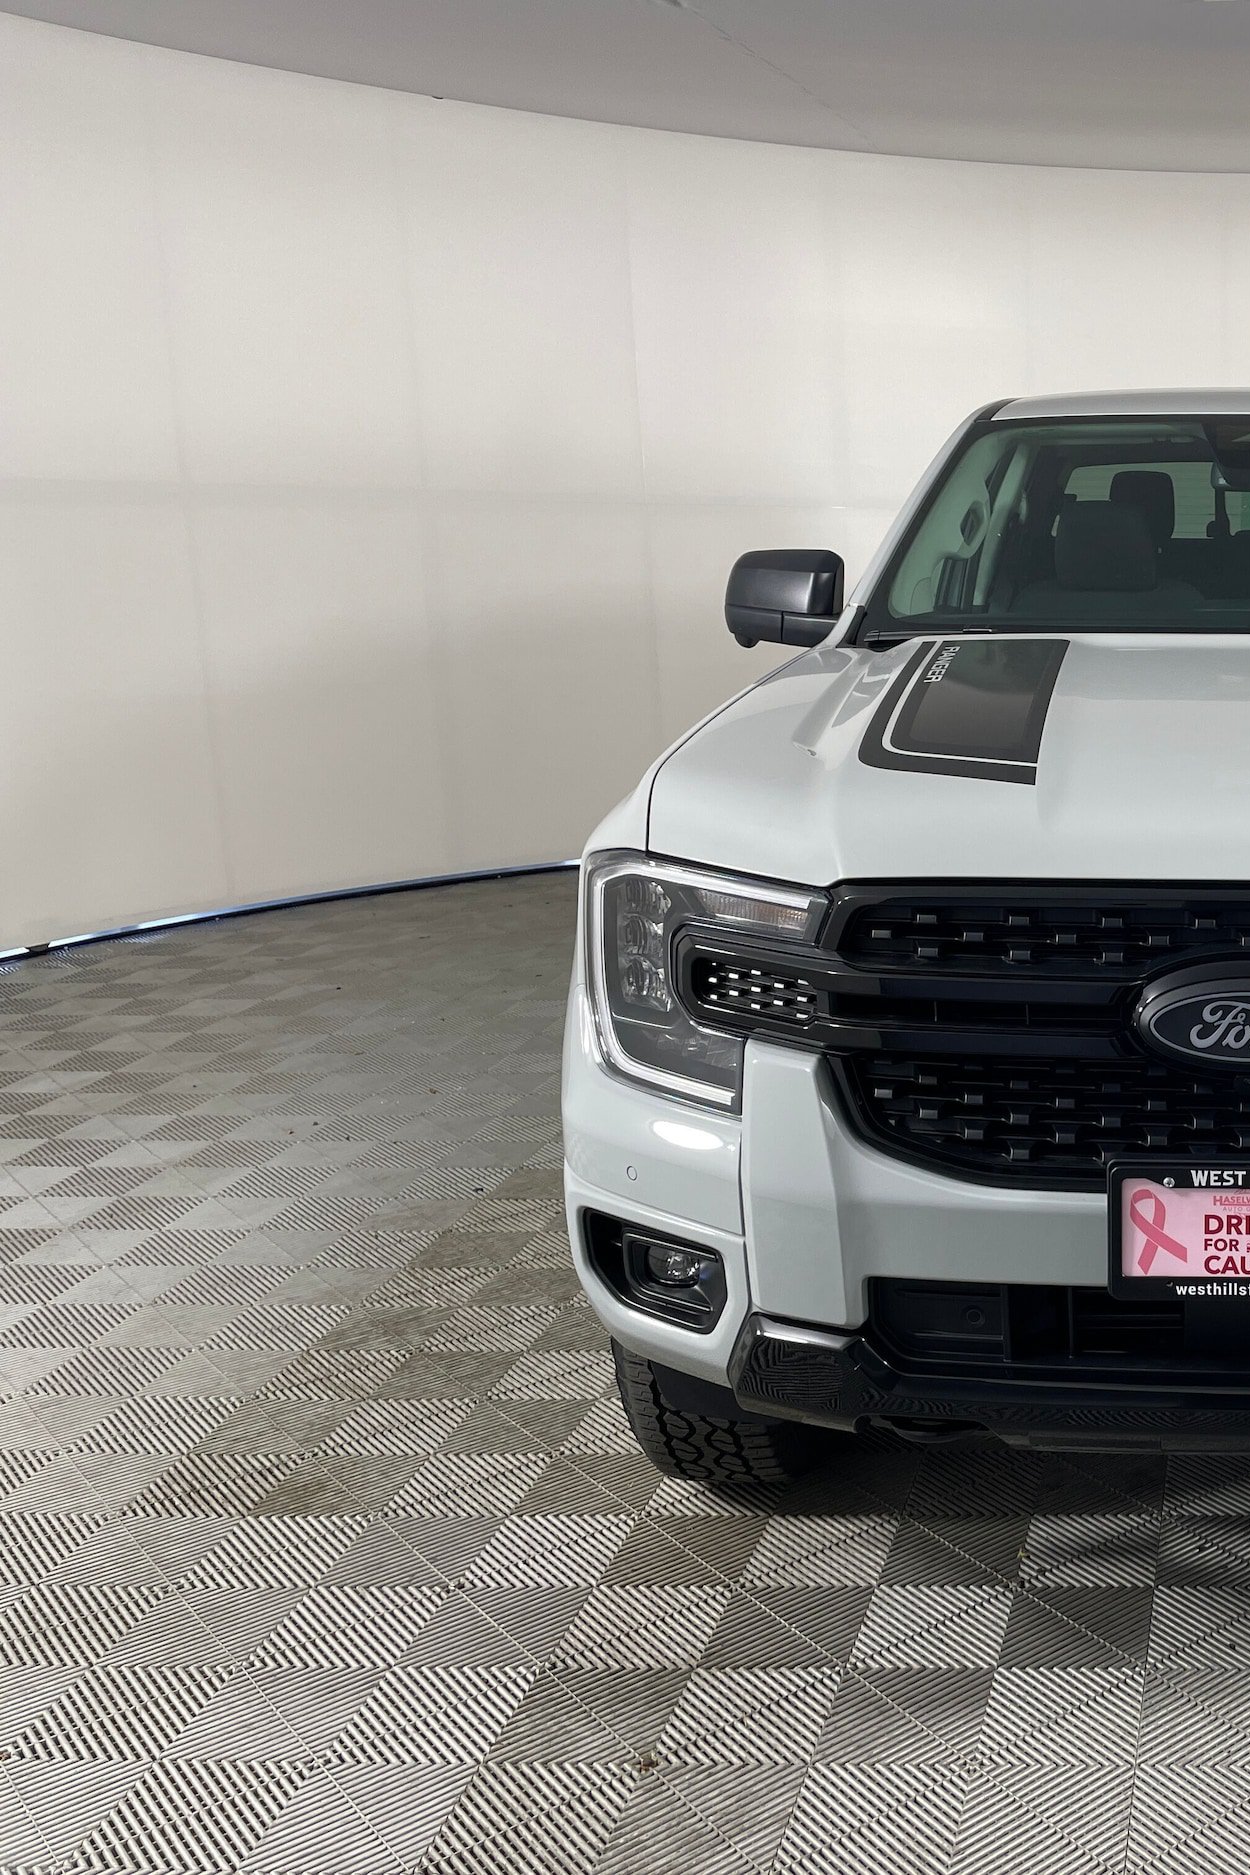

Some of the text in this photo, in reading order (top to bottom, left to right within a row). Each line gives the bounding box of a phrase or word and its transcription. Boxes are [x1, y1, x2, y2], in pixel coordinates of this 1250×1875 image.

[924, 646, 960, 683] RANGER
[1191, 1170, 1246, 1187] WEST
[1204, 1238, 1239, 1252] FOR
